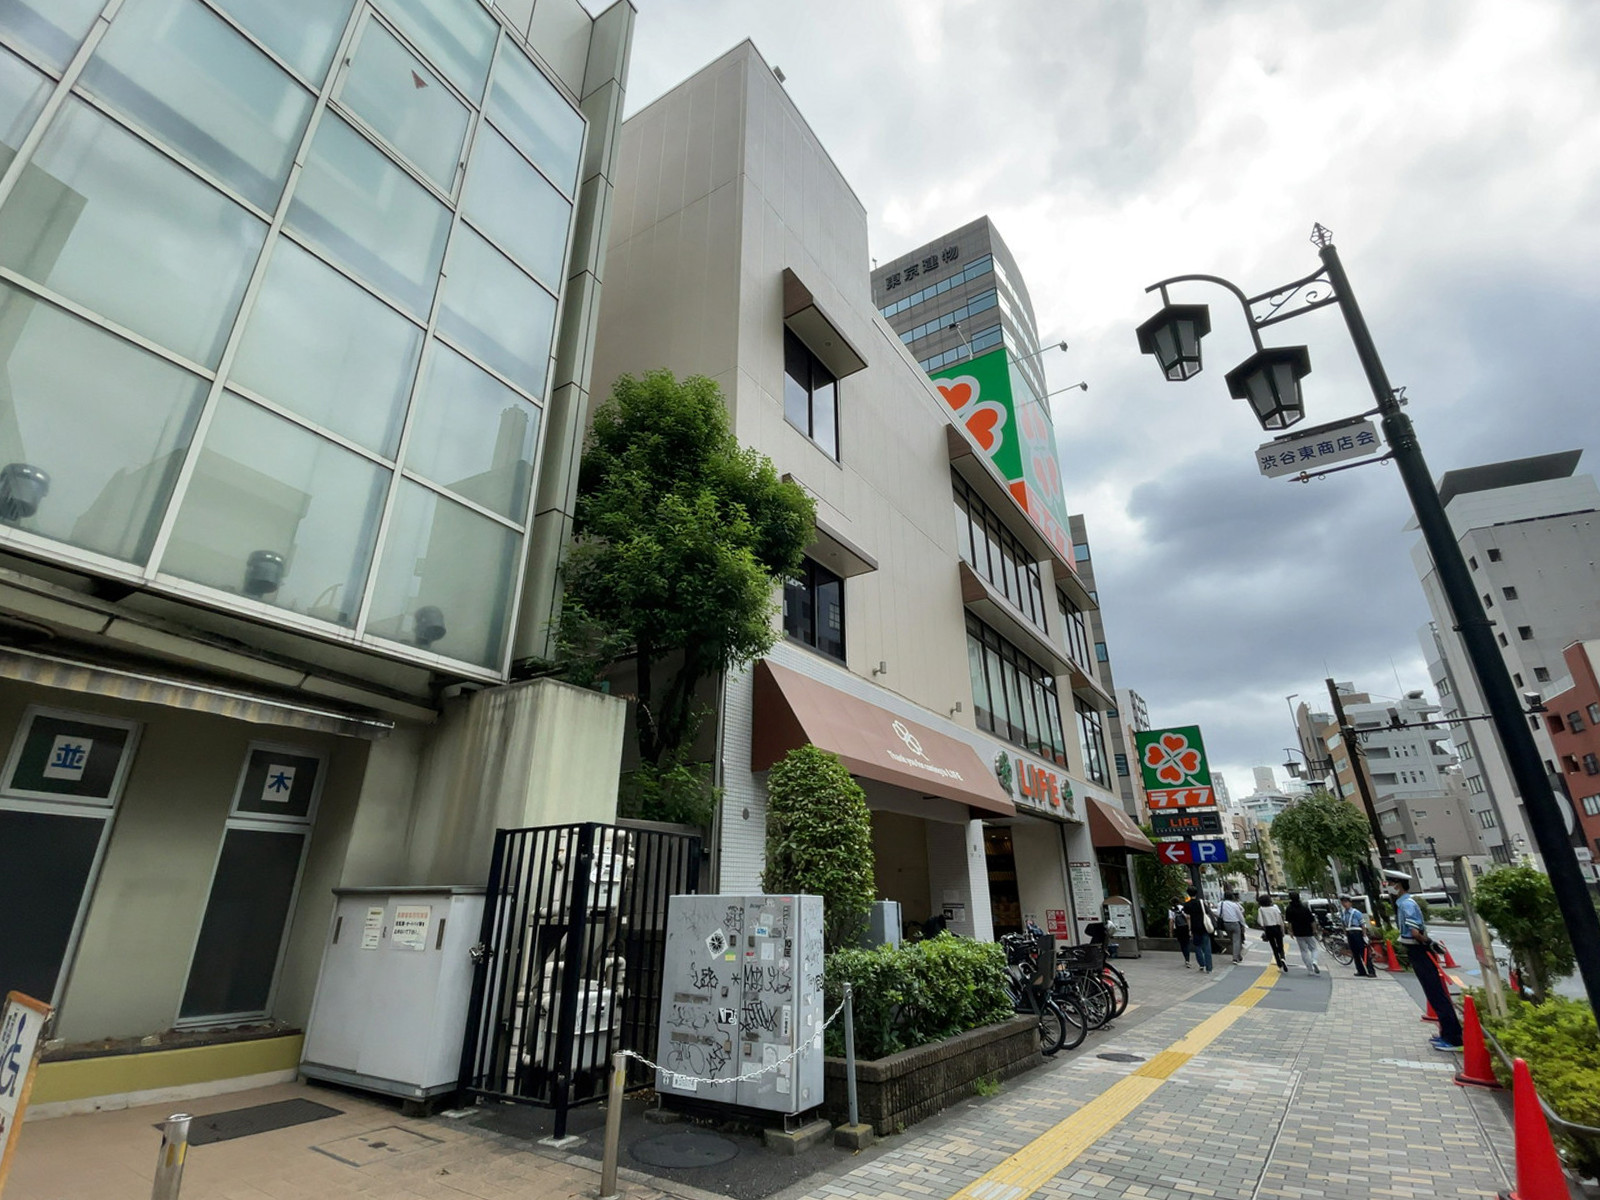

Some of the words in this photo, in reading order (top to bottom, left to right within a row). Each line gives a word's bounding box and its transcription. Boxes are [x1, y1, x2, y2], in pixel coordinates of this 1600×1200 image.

[885, 246, 959, 291] 東京建物
[1261, 431, 1376, 470] 渋谷東商店会
[51, 743, 86, 770] 並
[267, 771, 293, 793] 木
[1015, 758, 1061, 809] LIFE
[1150, 788, 1209, 807] ライフ
[1169, 817, 1200, 828] LIFE
[1198, 842, 1217, 862] P
